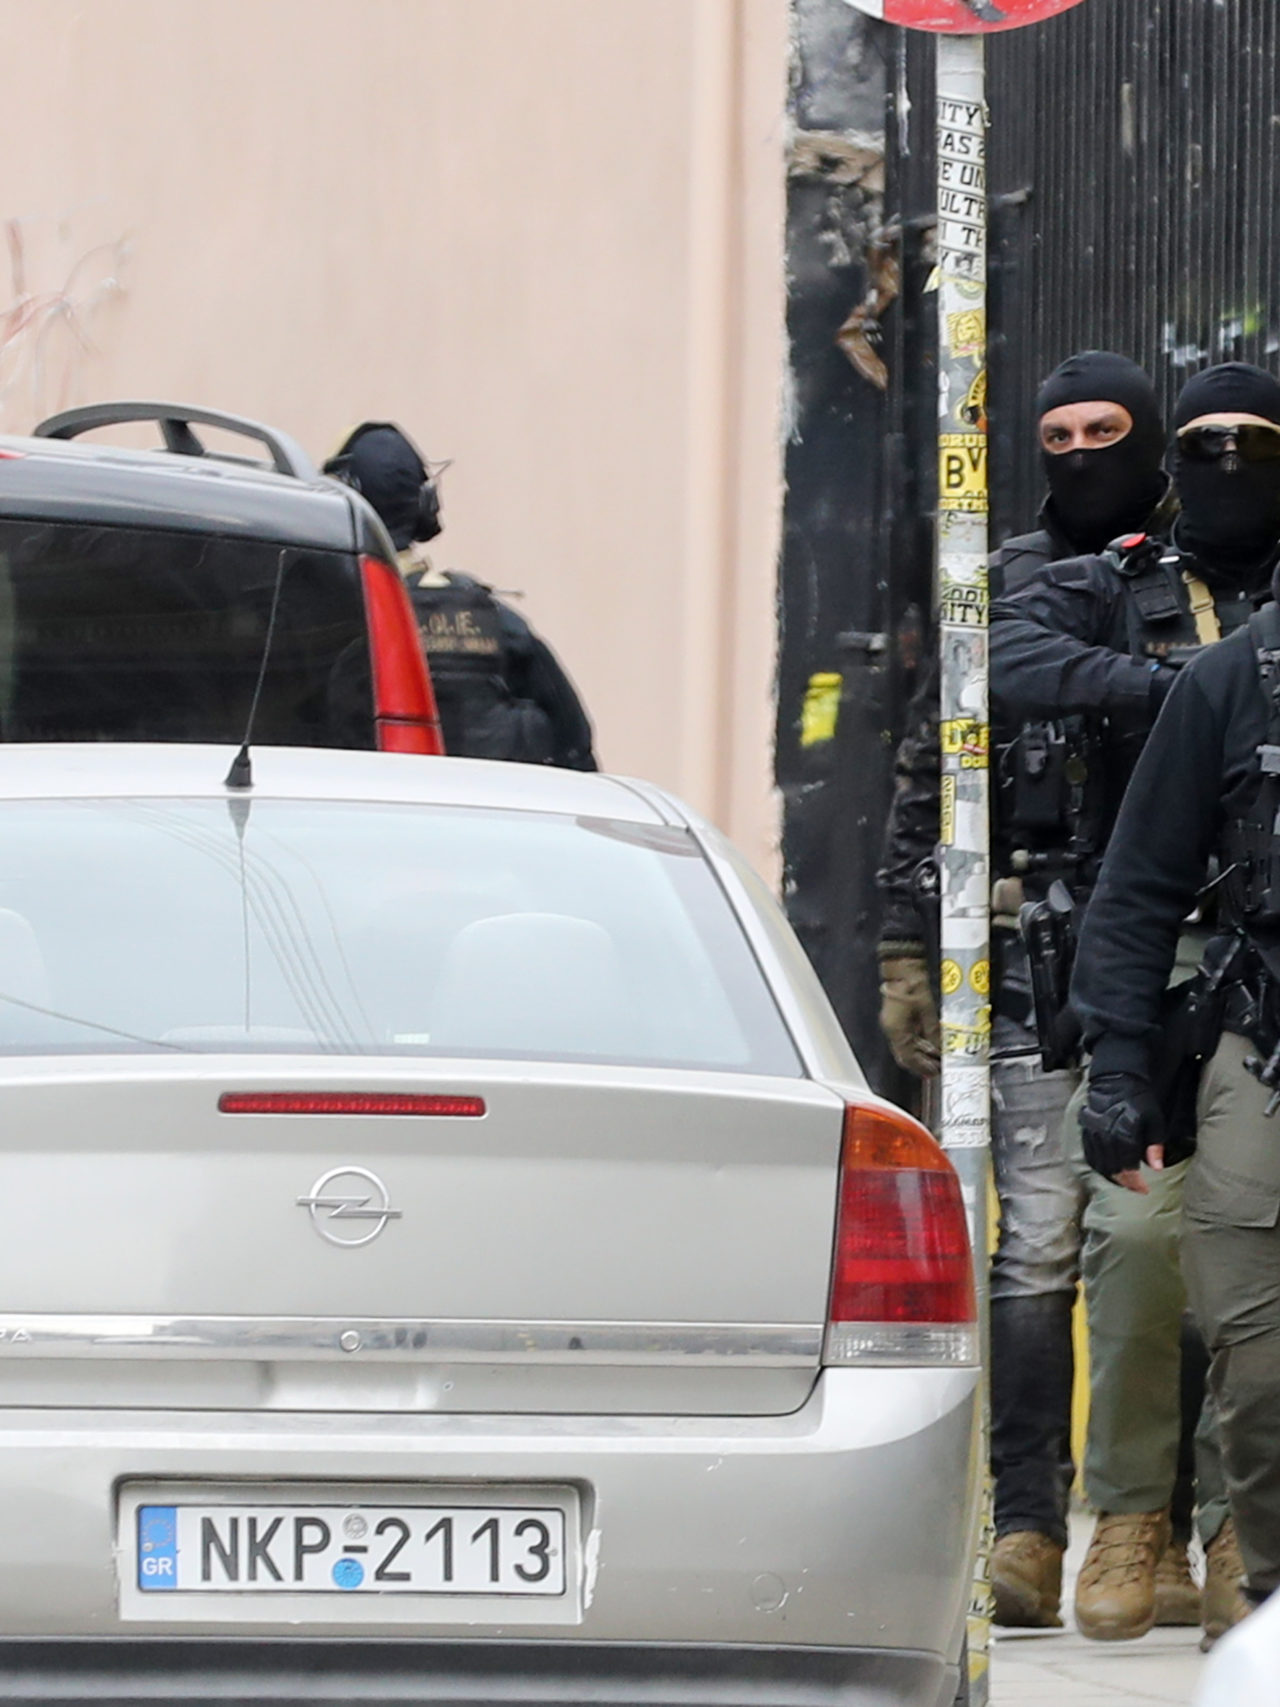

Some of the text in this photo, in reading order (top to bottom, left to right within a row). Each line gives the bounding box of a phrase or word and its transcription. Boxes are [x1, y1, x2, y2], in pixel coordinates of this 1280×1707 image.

[938, 102, 979, 125] ITY
[938, 131, 972, 154] AS
[201, 1516, 551, 1583] NKP-2113
[142, 1557, 173, 1576] GR
